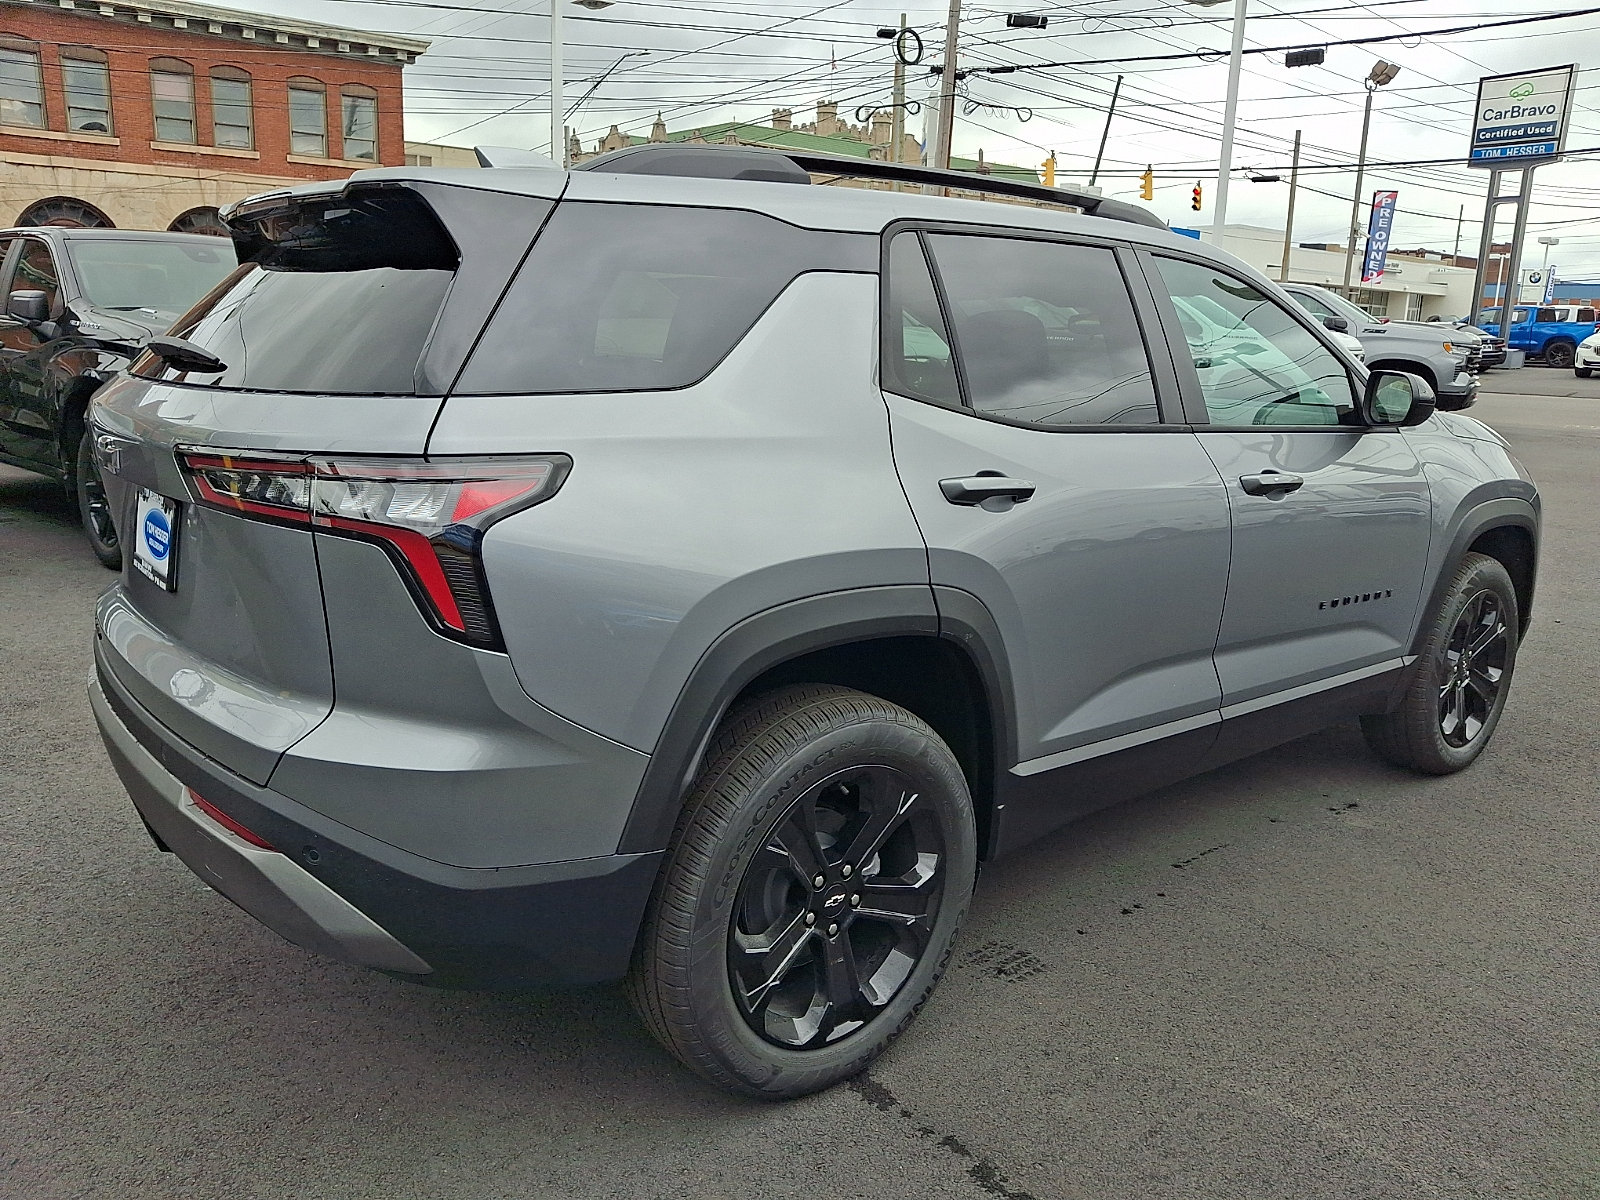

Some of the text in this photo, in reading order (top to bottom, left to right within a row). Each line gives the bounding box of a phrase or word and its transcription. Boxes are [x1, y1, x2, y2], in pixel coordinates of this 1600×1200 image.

[1482, 104, 1556, 121] CarBravo
[1479, 124, 1553, 139] Certified Used
[1480, 145, 1546, 158] TOM HESSER
[1368, 197, 1392, 279] PRE OWNED
